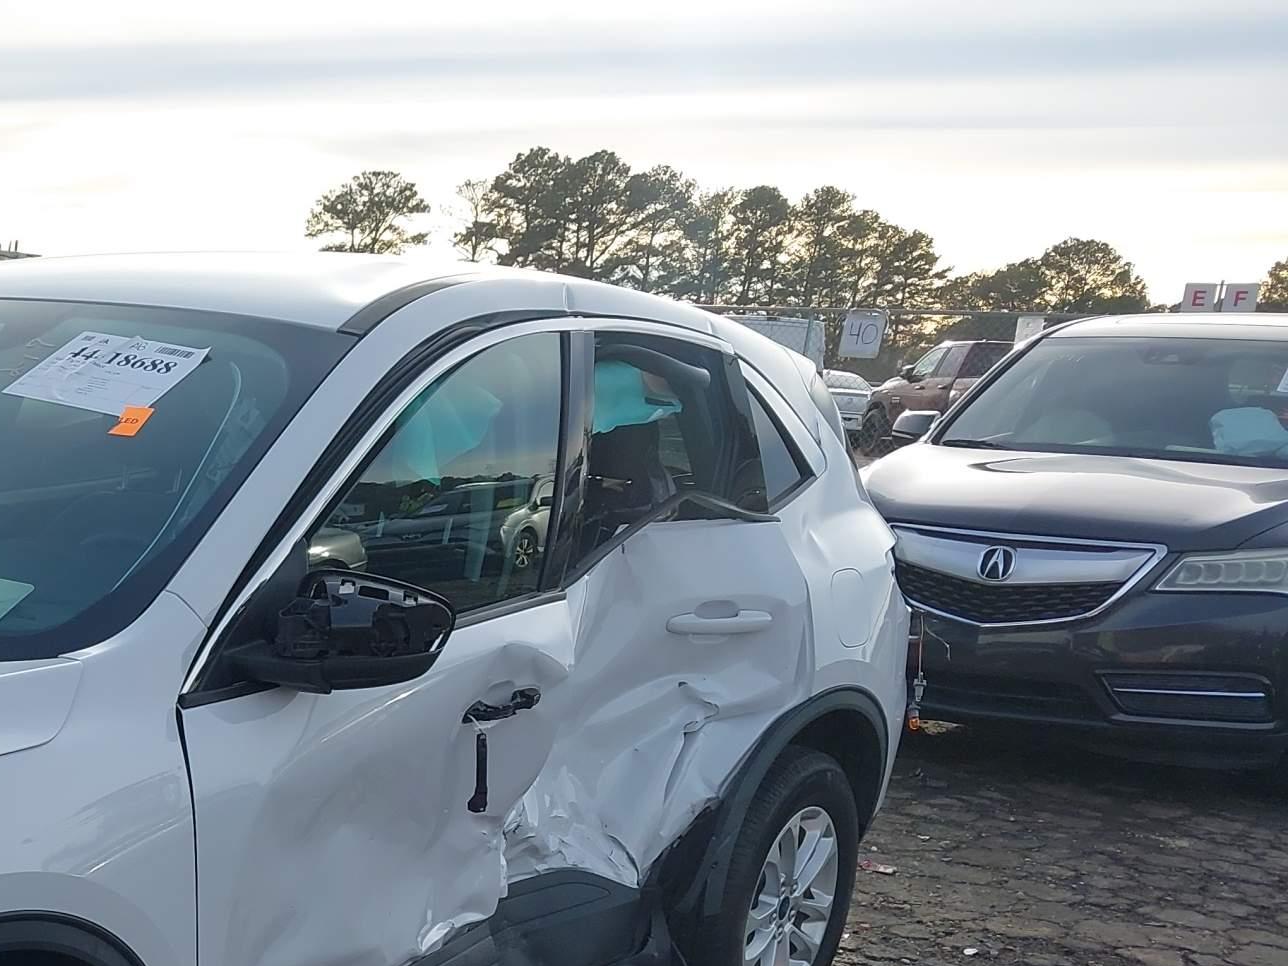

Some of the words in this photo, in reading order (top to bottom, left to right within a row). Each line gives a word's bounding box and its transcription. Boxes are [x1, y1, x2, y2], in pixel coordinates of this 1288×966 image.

[1192, 290, 1207, 307] E
[1233, 290, 1249, 307] F
[849, 321, 879, 344] 40
